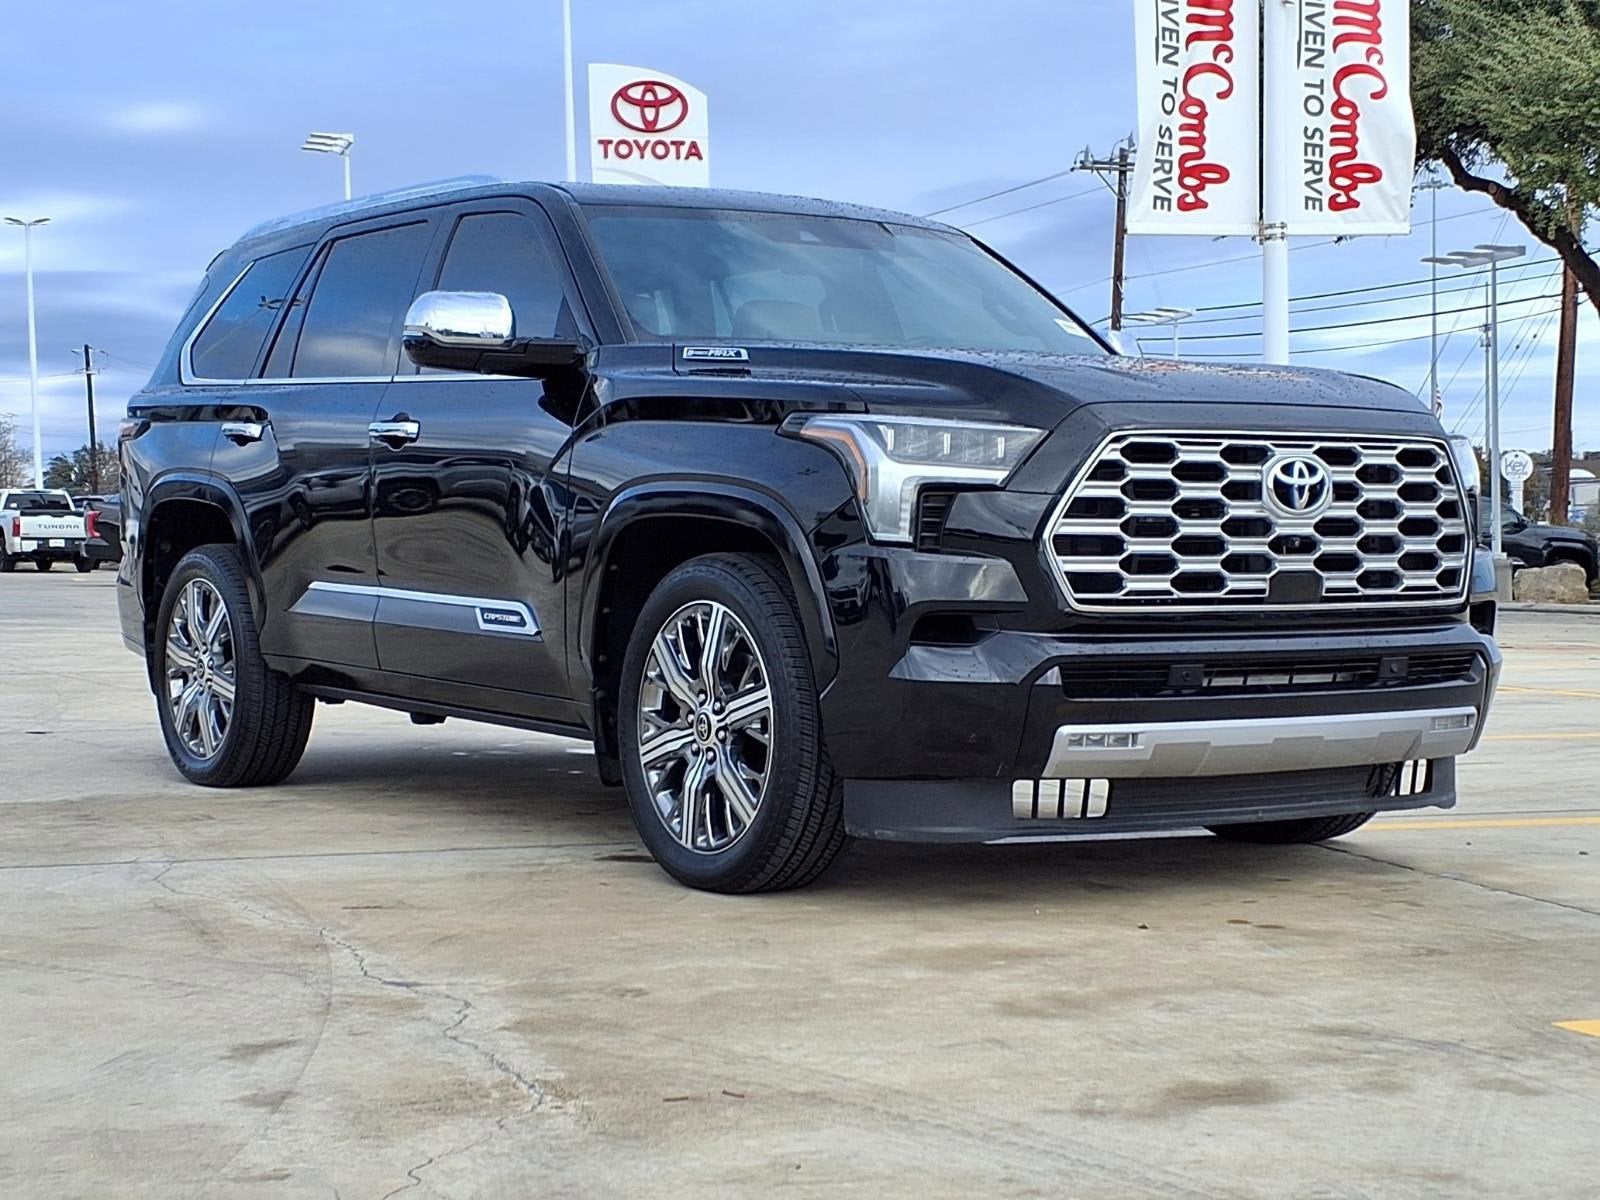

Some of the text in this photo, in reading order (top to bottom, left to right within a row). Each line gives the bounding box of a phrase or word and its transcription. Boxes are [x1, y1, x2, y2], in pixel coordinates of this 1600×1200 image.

[1161, 77, 1178, 116] TO
[1303, 79, 1325, 117] TO
[597, 139, 703, 161] TOYOTA
[1152, 124, 1173, 212] SERVE
[1304, 126, 1324, 212] SERVE
